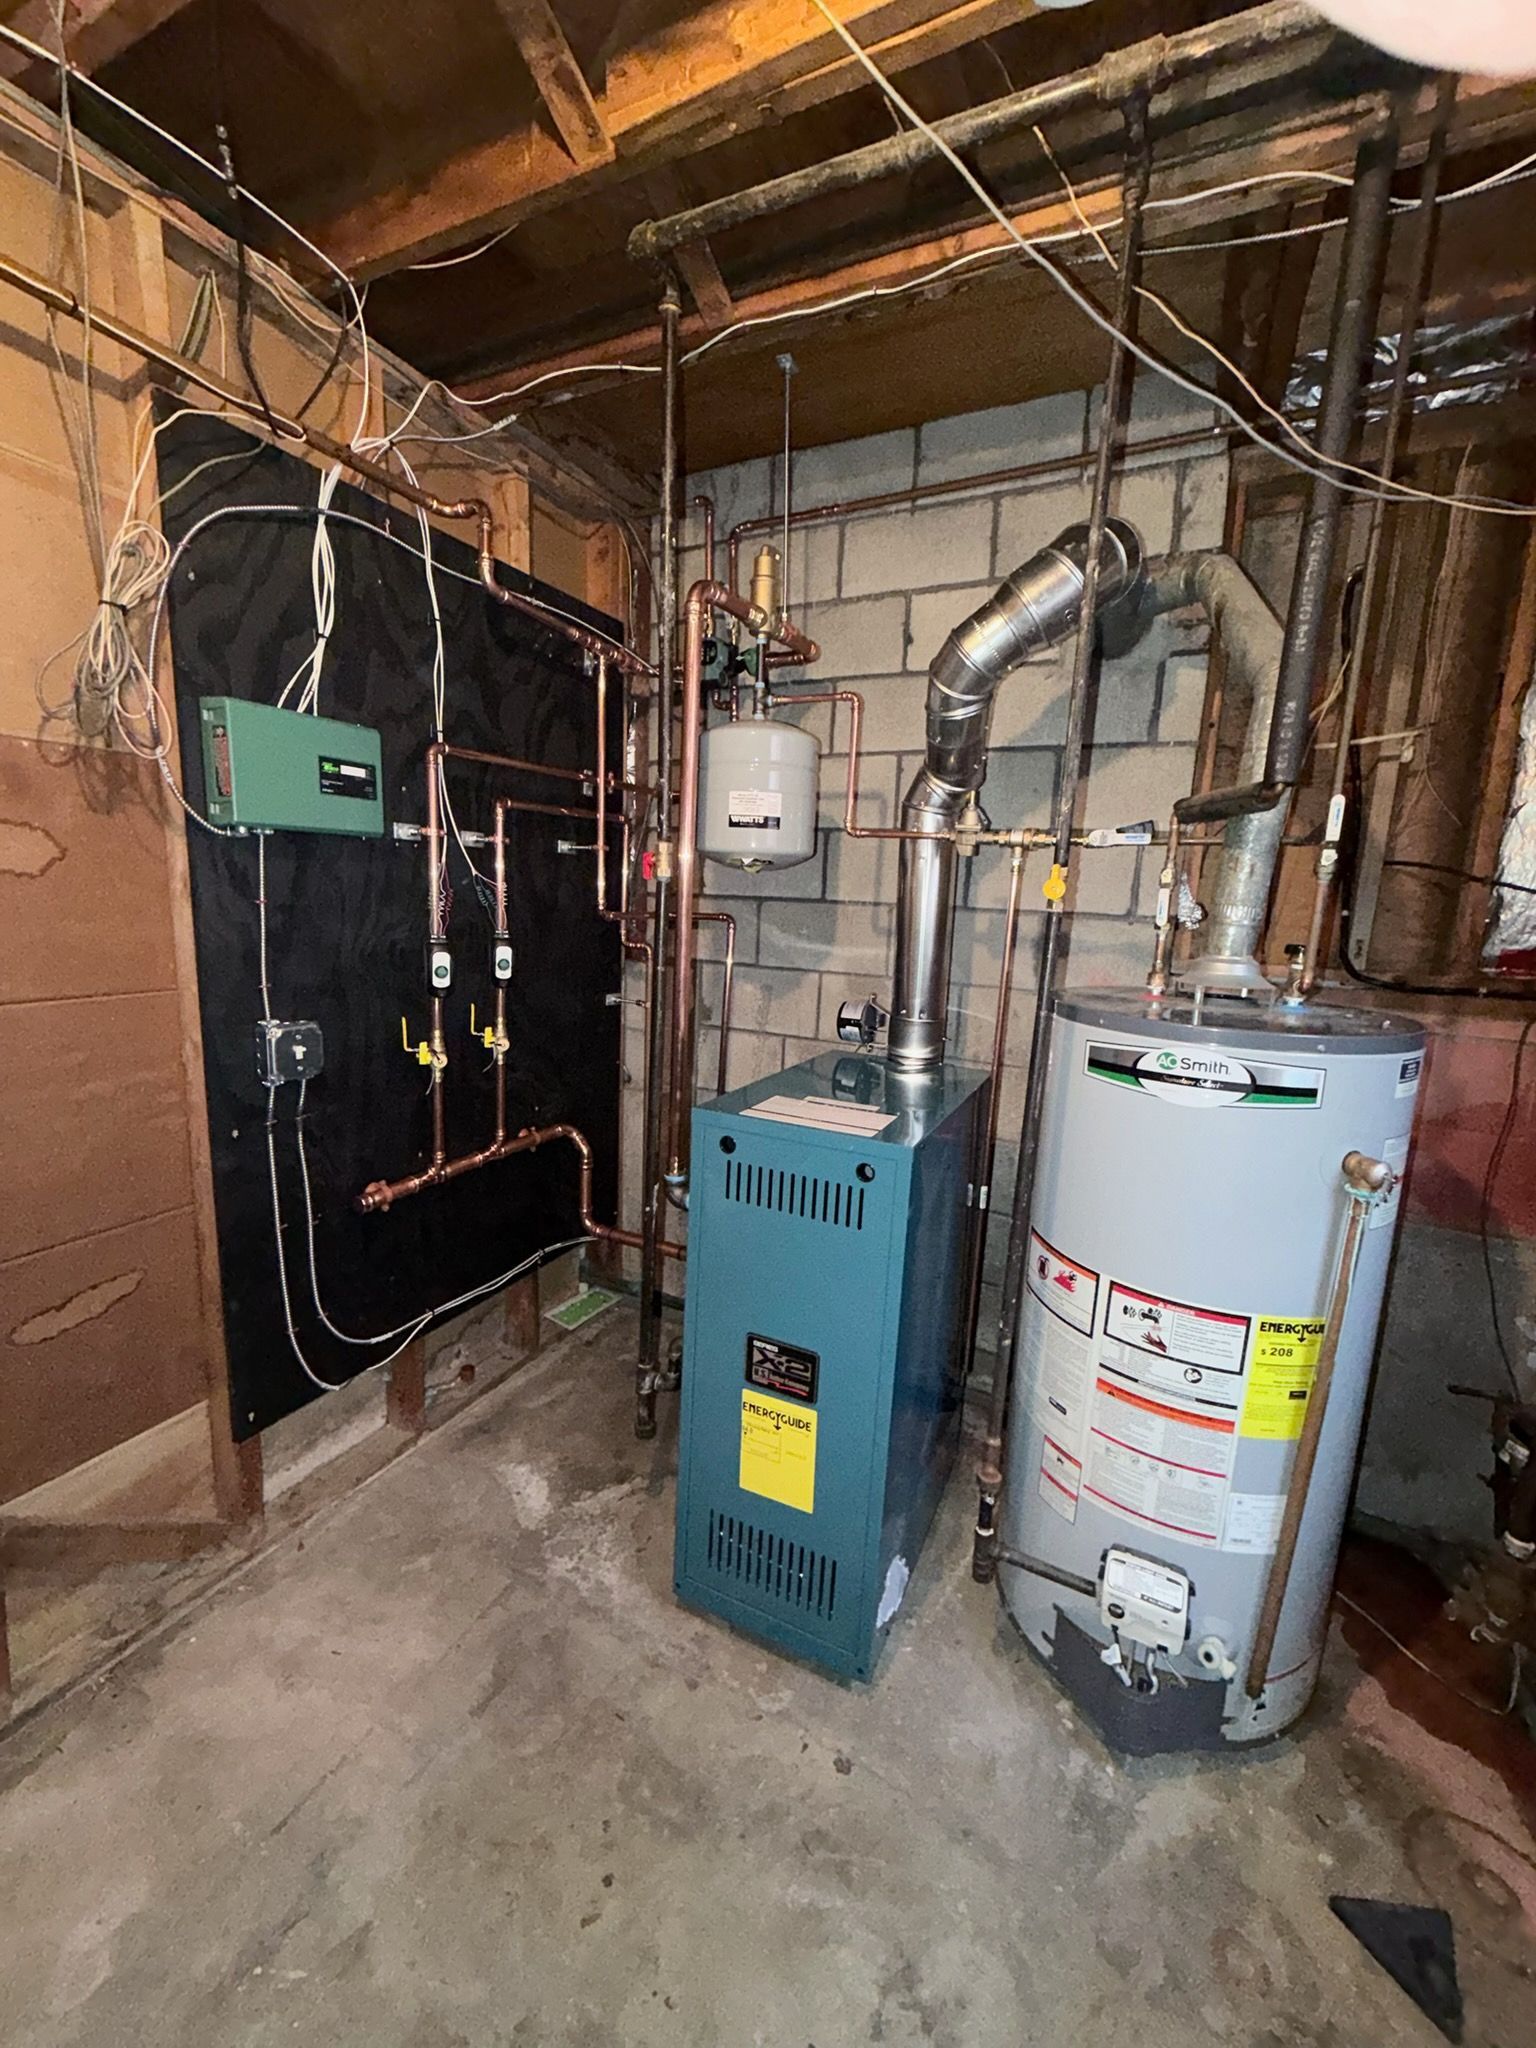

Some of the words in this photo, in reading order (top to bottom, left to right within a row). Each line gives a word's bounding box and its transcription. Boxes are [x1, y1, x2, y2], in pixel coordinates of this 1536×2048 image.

[730, 815, 764, 824] WATTS
[1157, 1052, 1178, 1070] AO
[1180, 1057, 1230, 1076] Smith
[1270, 1347, 1294, 1357] 208
[742, 1401, 812, 1432] ENERGYGUIDE
